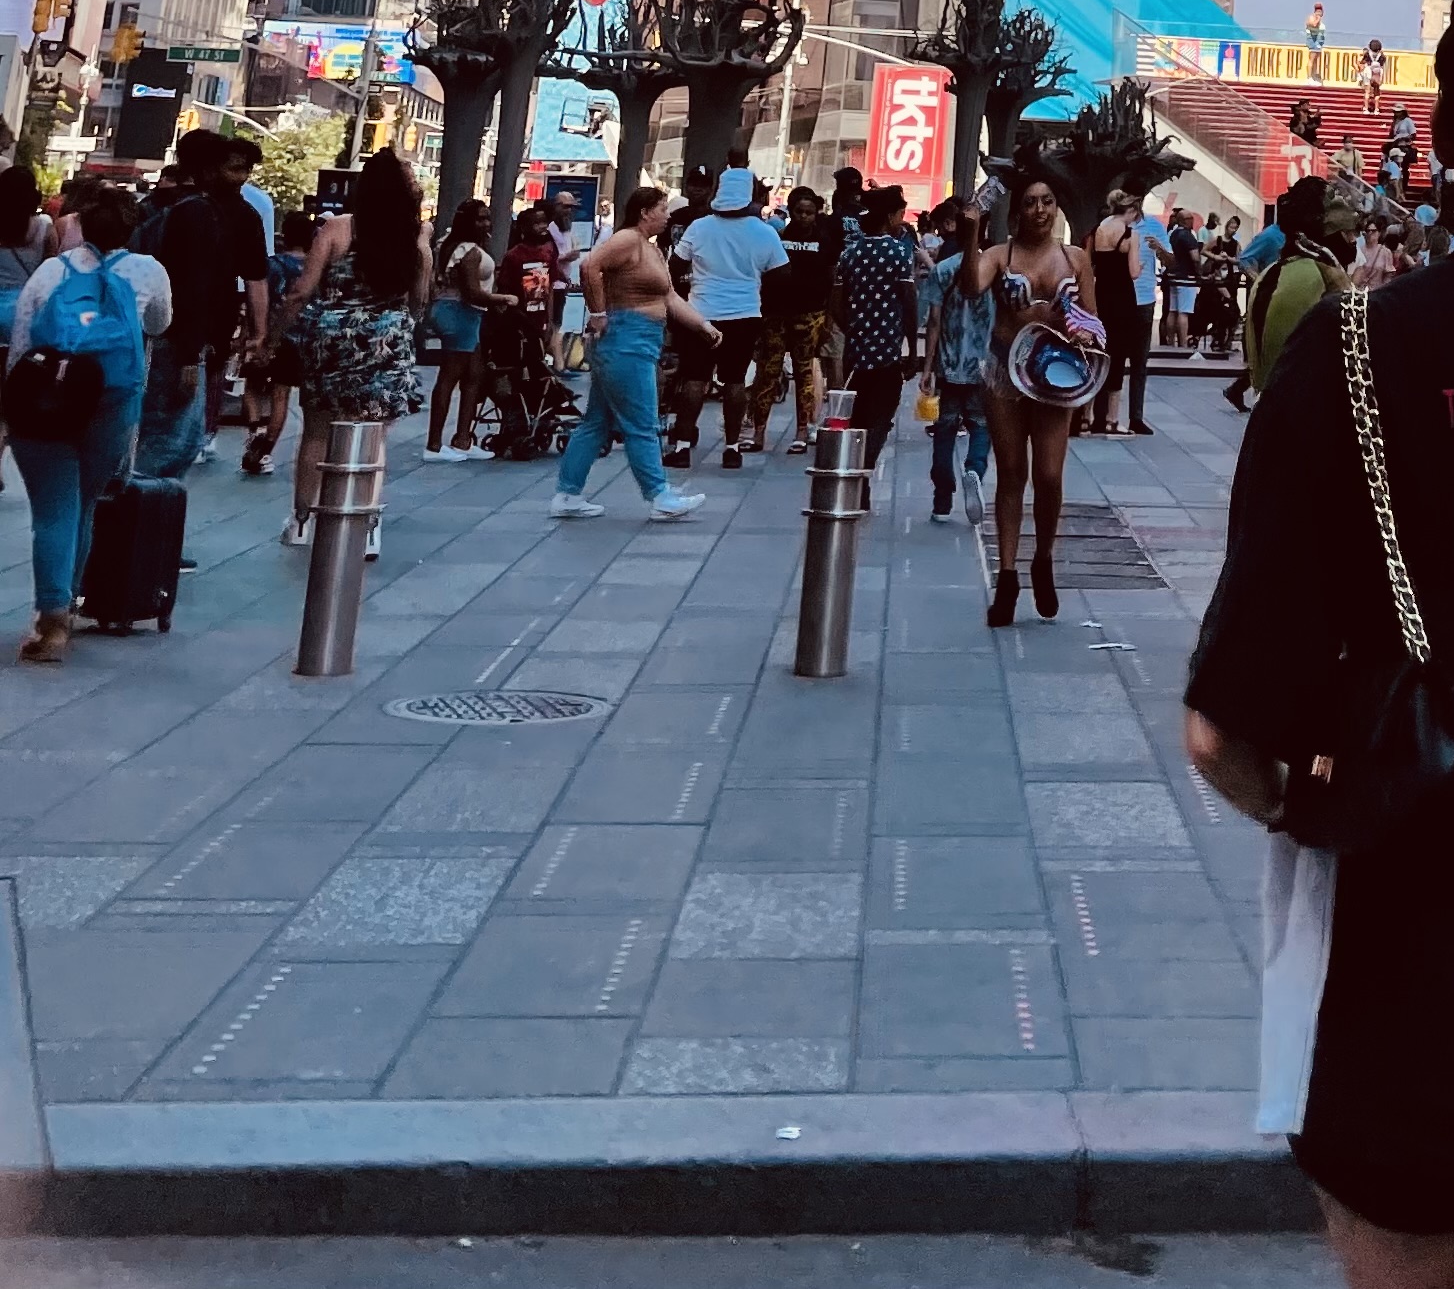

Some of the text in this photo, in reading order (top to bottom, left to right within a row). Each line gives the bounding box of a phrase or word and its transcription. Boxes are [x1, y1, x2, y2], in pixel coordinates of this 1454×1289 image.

[184, 49, 194, 59] W
[1246, 46, 1360, 82] MAKE UP LOS
[886, 76, 939, 172] tkts
